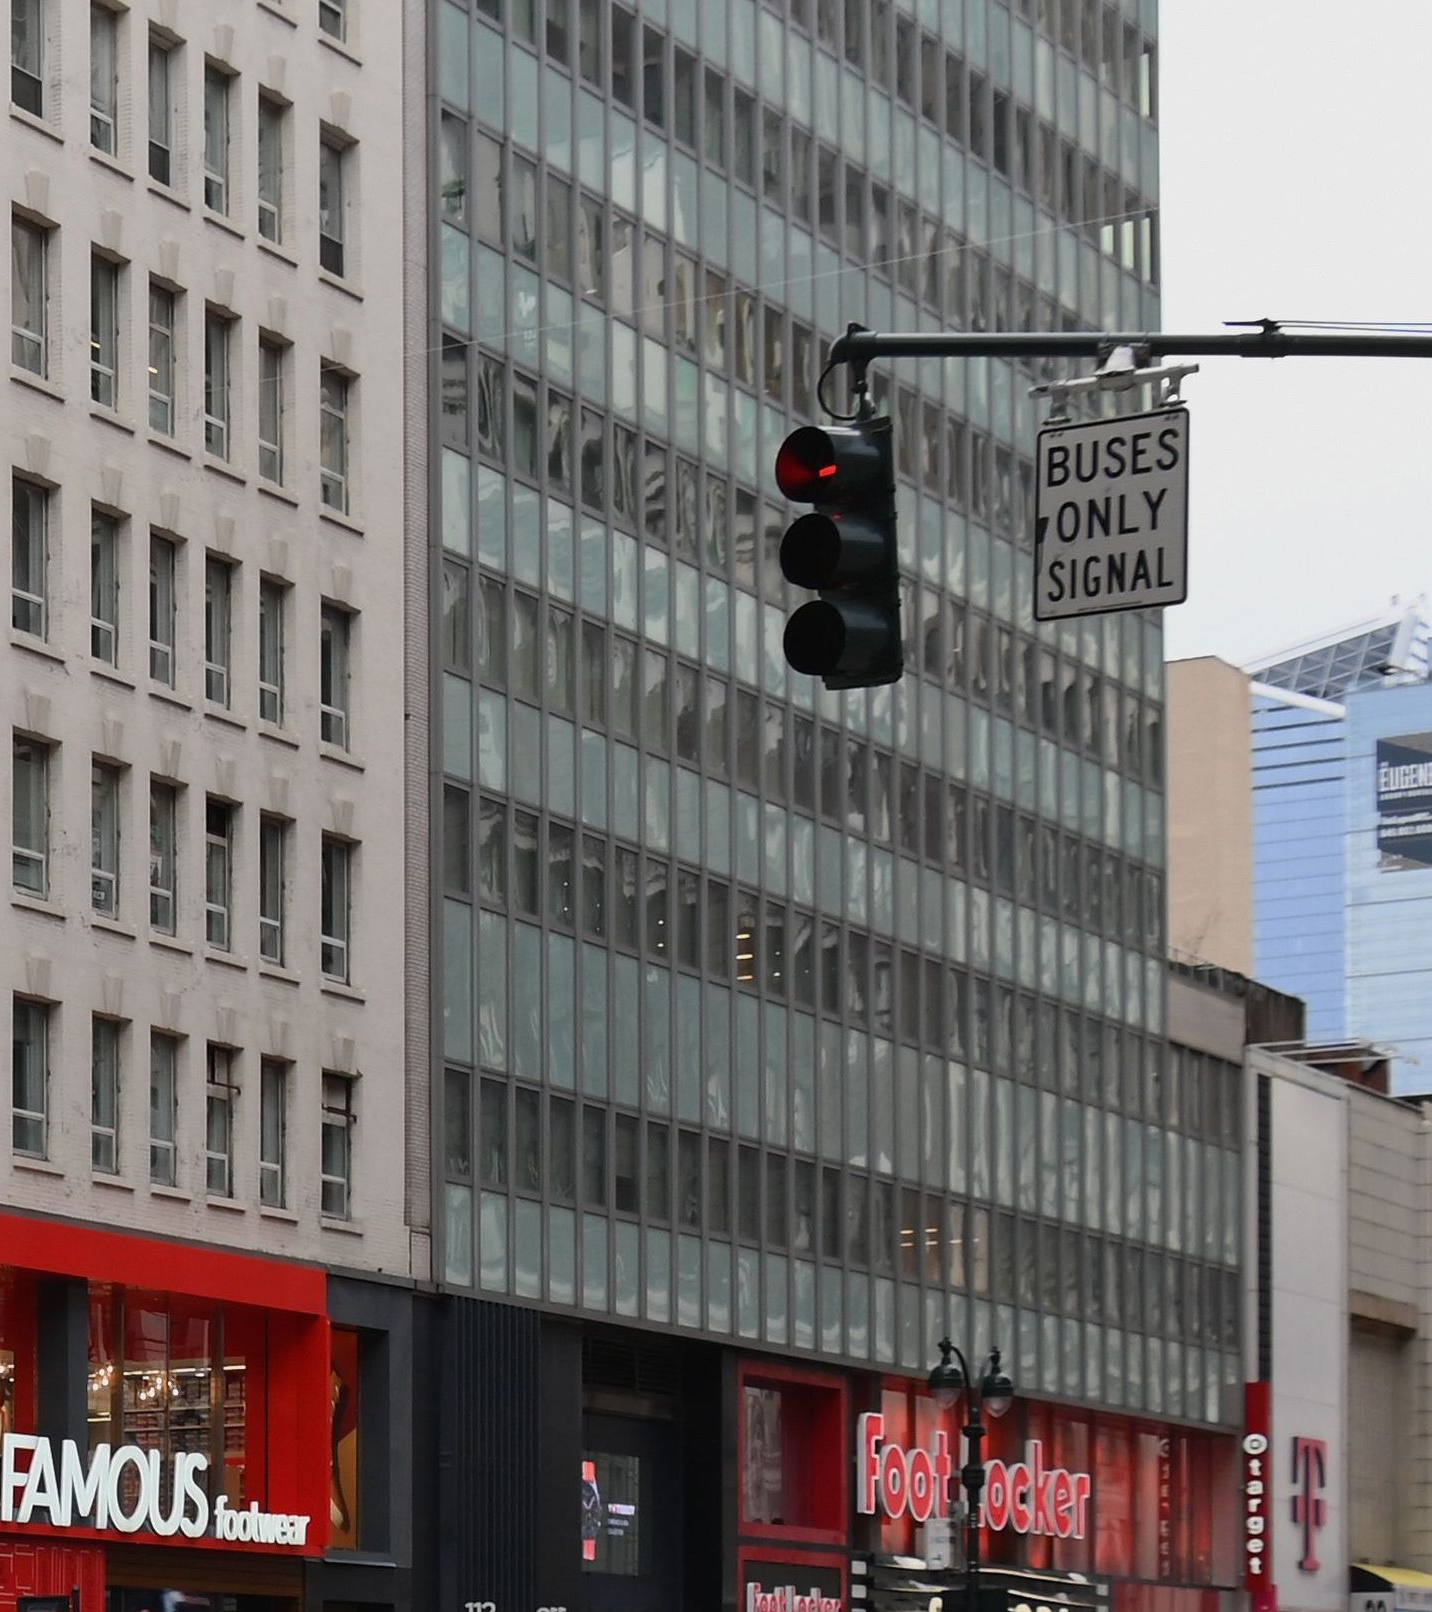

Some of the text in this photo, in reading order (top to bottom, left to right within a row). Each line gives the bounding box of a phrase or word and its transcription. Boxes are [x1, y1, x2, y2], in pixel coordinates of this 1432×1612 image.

[1047, 428, 1180, 488] BUSES
[1056, 488, 1167, 543] ONLY
[1048, 547, 1174, 602] SIGNAL
[1, 1433, 311, 1546] FAMOUS footwear
[857, 1412, 951, 1522] Foot
